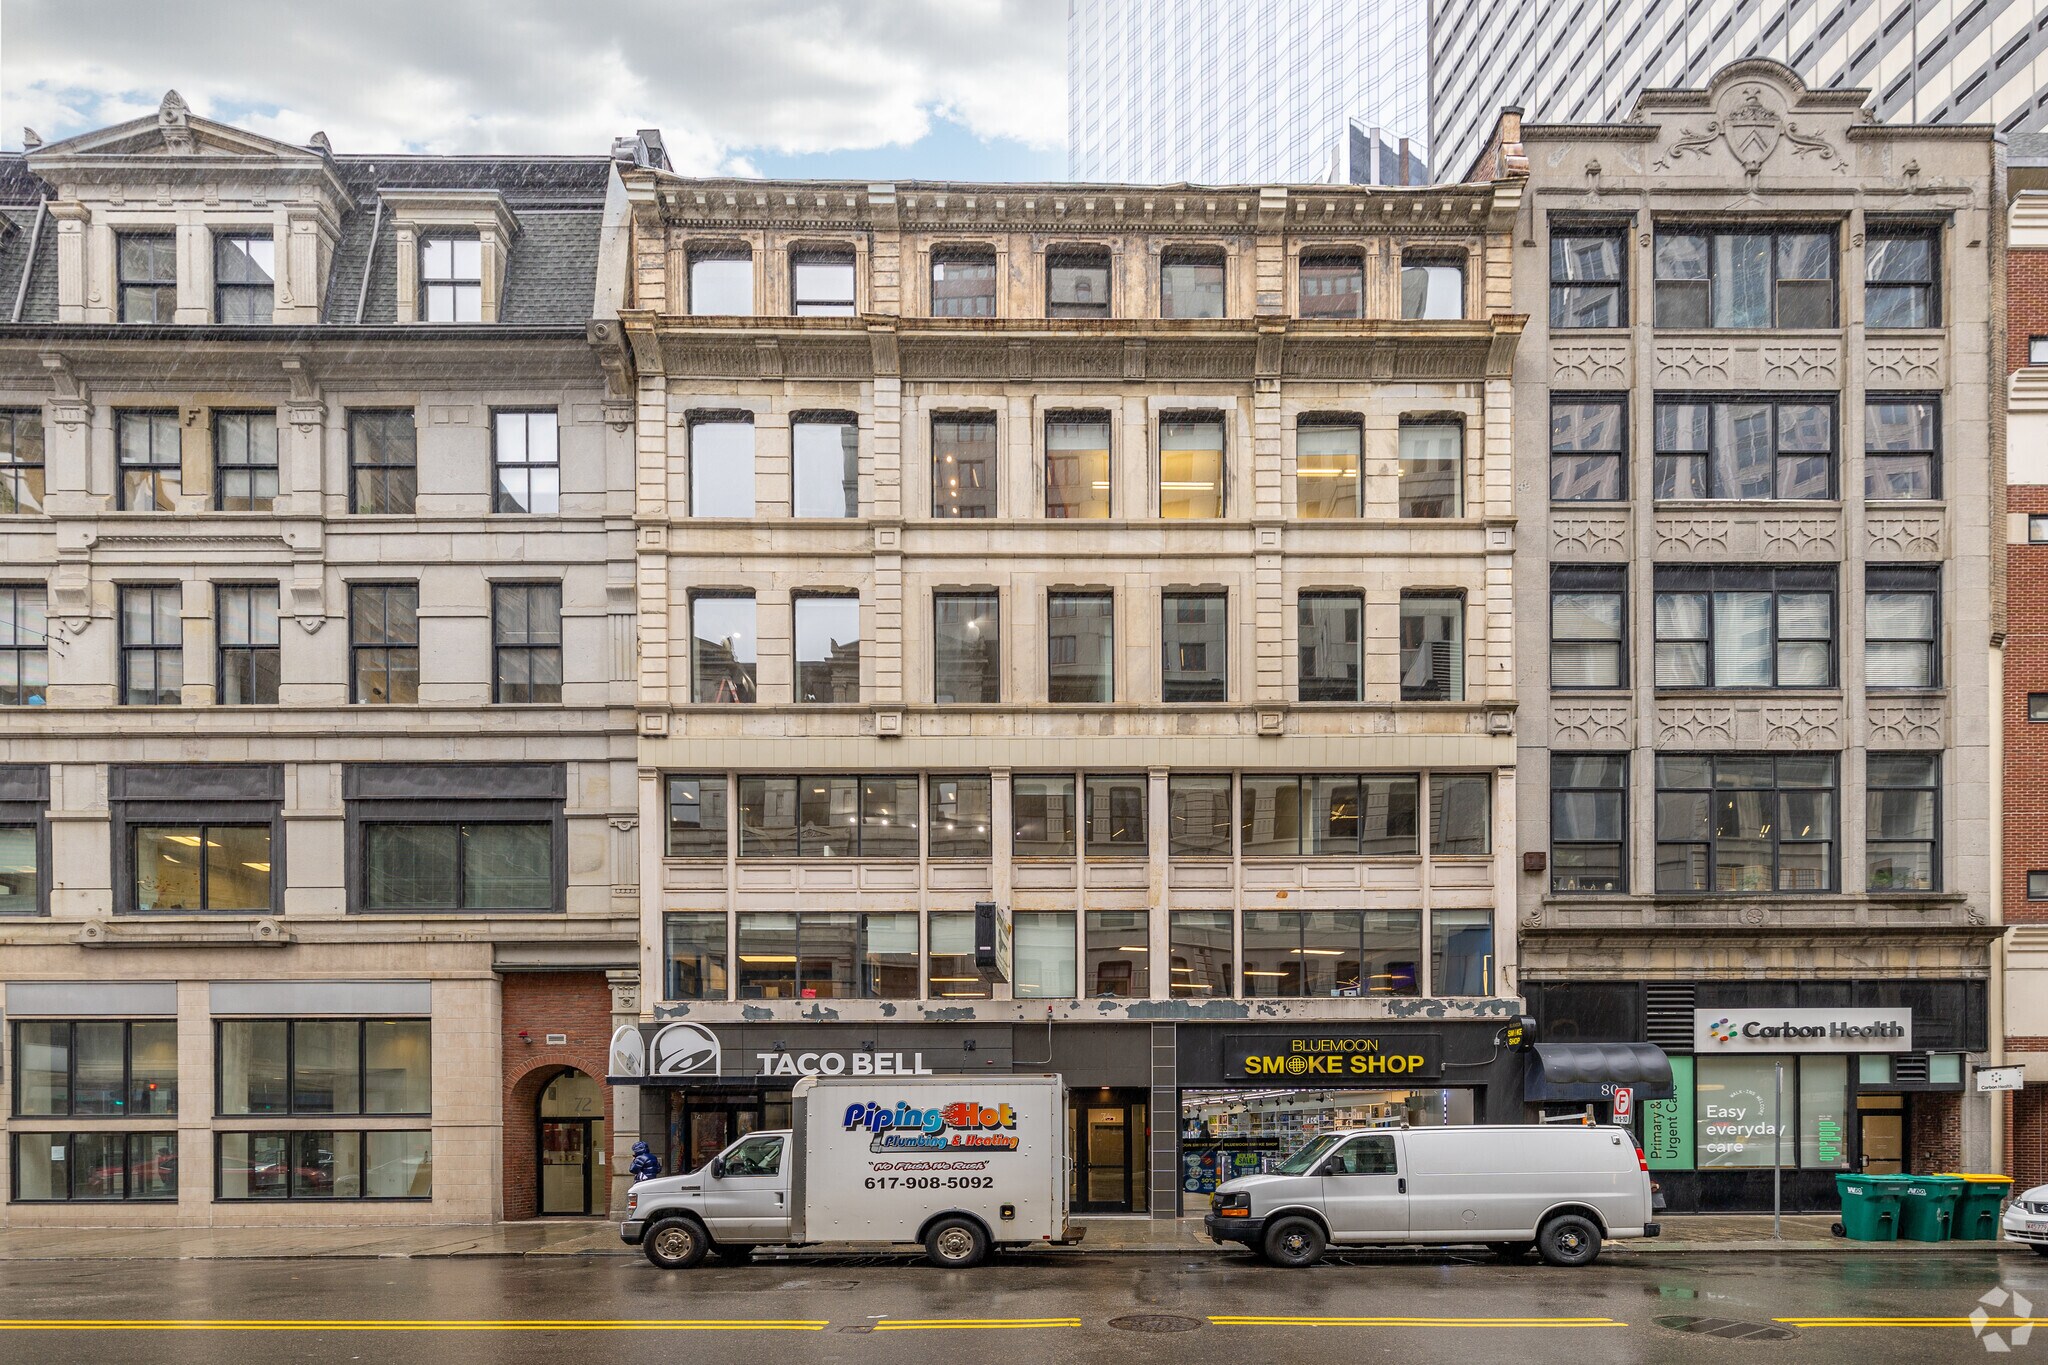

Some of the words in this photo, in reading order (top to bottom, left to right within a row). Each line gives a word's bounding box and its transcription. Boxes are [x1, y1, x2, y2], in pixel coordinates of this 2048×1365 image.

[1742, 1021, 1826, 1038] Carbon
[1829, 1020, 1904, 1038] Health
[1292, 1039, 1378, 1051] BLUEMOON
[756, 1053, 846, 1075] TACO
[852, 1053, 933, 1075] BELL
[1244, 1055, 1343, 1075] SMOKE
[1350, 1055, 1425, 1074] SHOP
[574, 1097, 592, 1112] 72
[1618, 1094, 1627, 1109] F
[1650, 1101, 1662, 1110] &
[842, 1101, 944, 1134] Piping
[944, 1102, 1015, 1129] Hot
[1706, 1105, 1746, 1120] Easy
[884, 1134, 949, 1149] Plumbing
[951, 1134, 962, 1147] &
[964, 1134, 1020, 1150] Heating
[1650, 1112, 1665, 1159] Primary
[1666, 1116, 1681, 1159] Urgent
[1706, 1142, 1744, 1153] care
[894, 1161, 931, 1171] Flush
[864, 1177, 994, 1190] 617-908-5092
